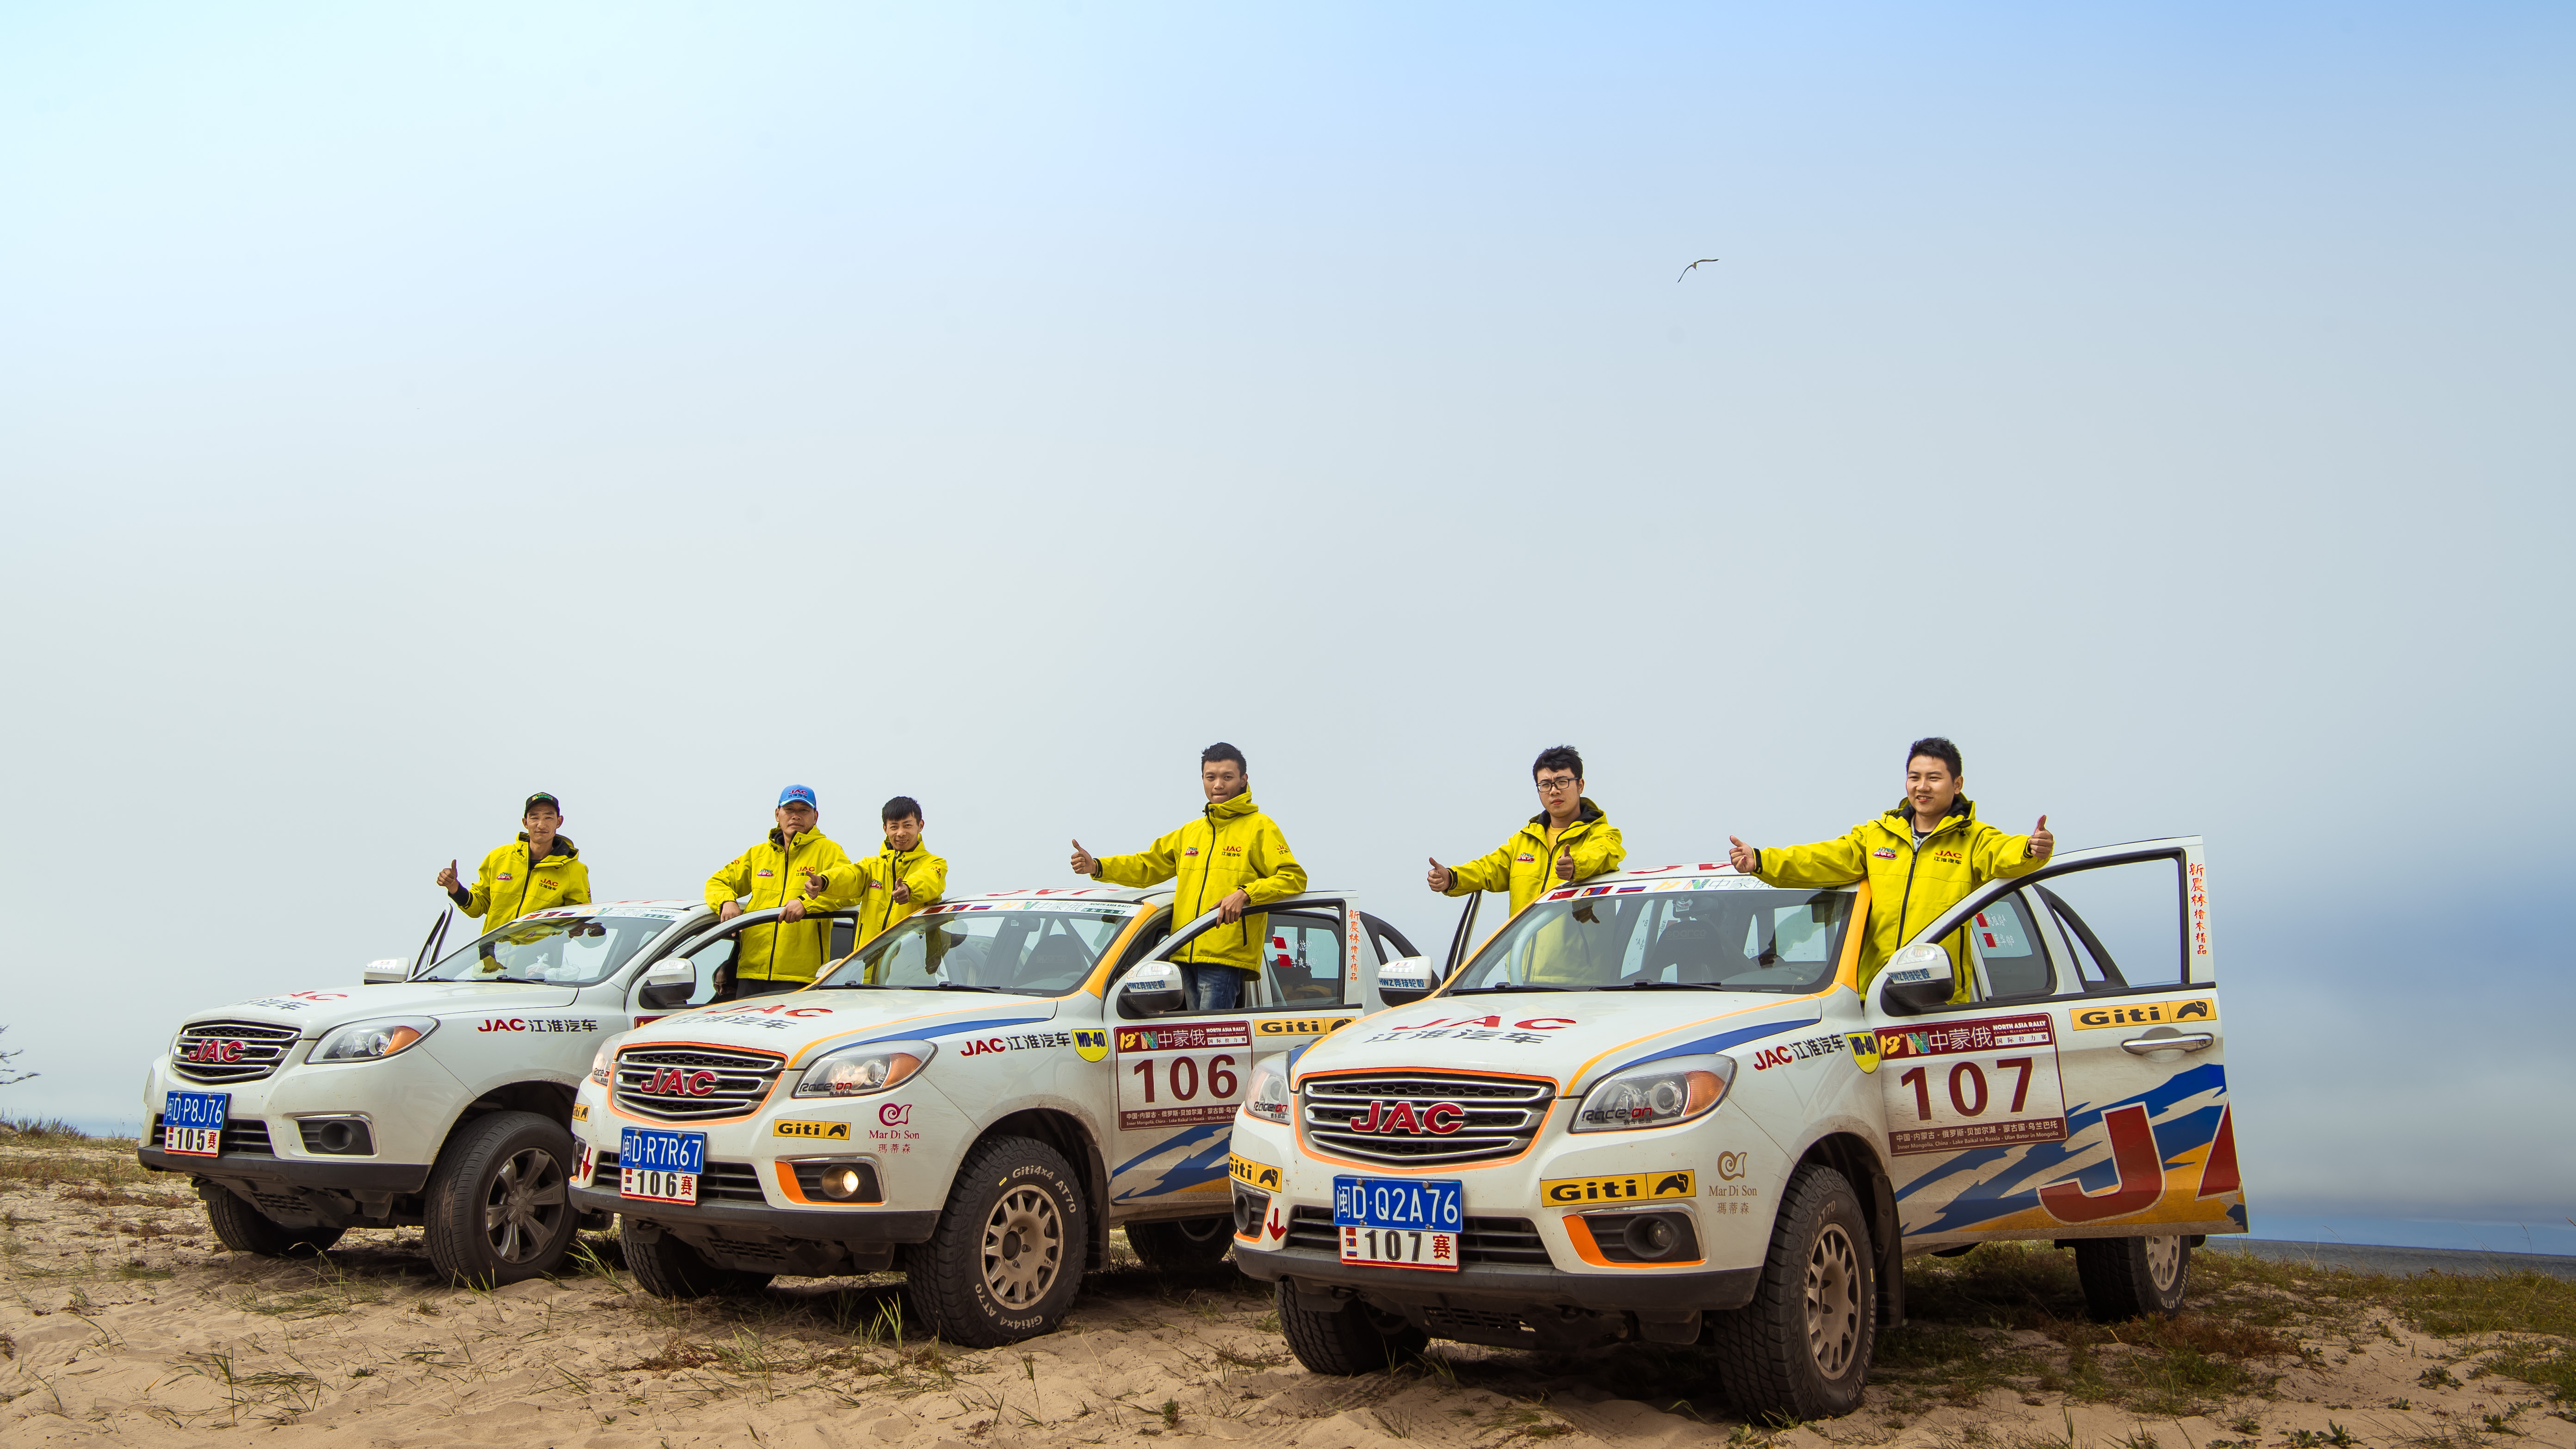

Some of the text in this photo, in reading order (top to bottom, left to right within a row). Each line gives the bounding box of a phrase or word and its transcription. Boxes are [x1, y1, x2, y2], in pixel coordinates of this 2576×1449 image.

[1933, 856, 1962, 864] 江淮汽车
[1935, 850, 1962, 859] JAC
[540, 878, 558, 887] JAC
[477, 1018, 598, 1032] JAC 江淮汽车
[1392, 1016, 1577, 1030] JAC
[2080, 1006, 2160, 1025] Giti
[1261, 1021, 1319, 1033] Giti
[1362, 1029, 1552, 1043] 江淮汽车
[960, 1032, 1071, 1057] JAC 江淮汽车
[1075, 1032, 1107, 1047] WD-40
[1158, 1028, 1206, 1047] 中蒙俄
[1849, 1036, 1877, 1055] WD-40
[1930, 1026, 1993, 1051] 中蒙俄
[1996, 1034, 2047, 1044] 国际拉力赛
[188, 1040, 245, 1062] JAC
[1753, 1034, 1845, 1071] JAC 江淮汽车
[640, 1068, 717, 1096] JAC
[1134, 1054, 1238, 1103] 106
[1901, 1057, 2033, 1121] 107
[1350, 1101, 1465, 1134] JAC
[778, 1122, 820, 1136] Giti
[869, 1130, 919, 1139] Mar Di Son
[177, 1128, 205, 1151] 105
[878, 1144, 910, 1154] 瑪蒂森
[638, 1170, 693, 1197] 106 赛
[1012, 1165, 1076, 1213] Giti4x4 AT70
[1550, 1179, 1637, 1201] Giti
[1709, 1185, 1757, 1196] Mar Di Son
[1717, 1202, 1749, 1214] 瑪蒂森
[1817, 1200, 1836, 1227] AT70
[1365, 1229, 1450, 1262] 107 赛
[975, 1283, 1042, 1330] Giti4x4 AT70
[1863, 1294, 1875, 1368] Giti4x4
